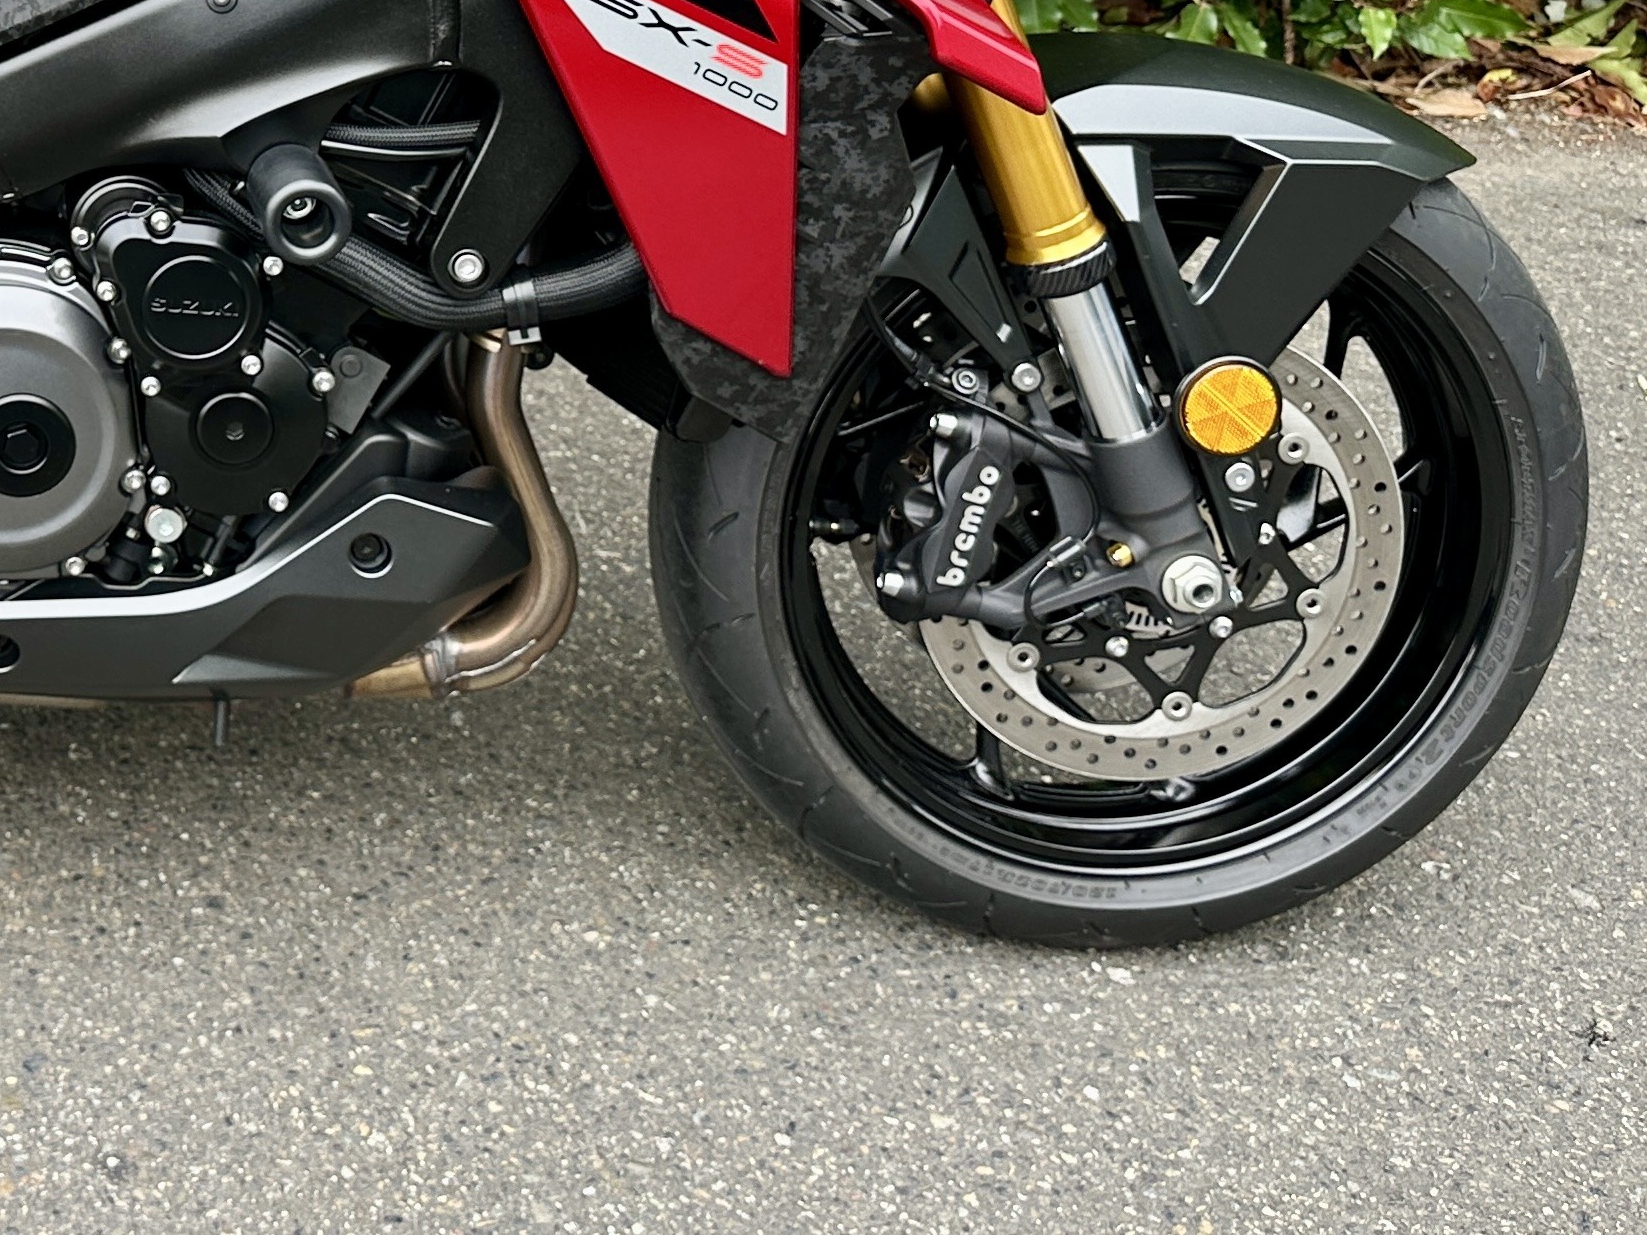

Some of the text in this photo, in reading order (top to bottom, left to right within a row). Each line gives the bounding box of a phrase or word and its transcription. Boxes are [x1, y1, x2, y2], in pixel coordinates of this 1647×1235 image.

[694, 61, 779, 112] 1000
[151, 298, 239, 316] SUZUKI
[936, 466, 1000, 586] brembo
